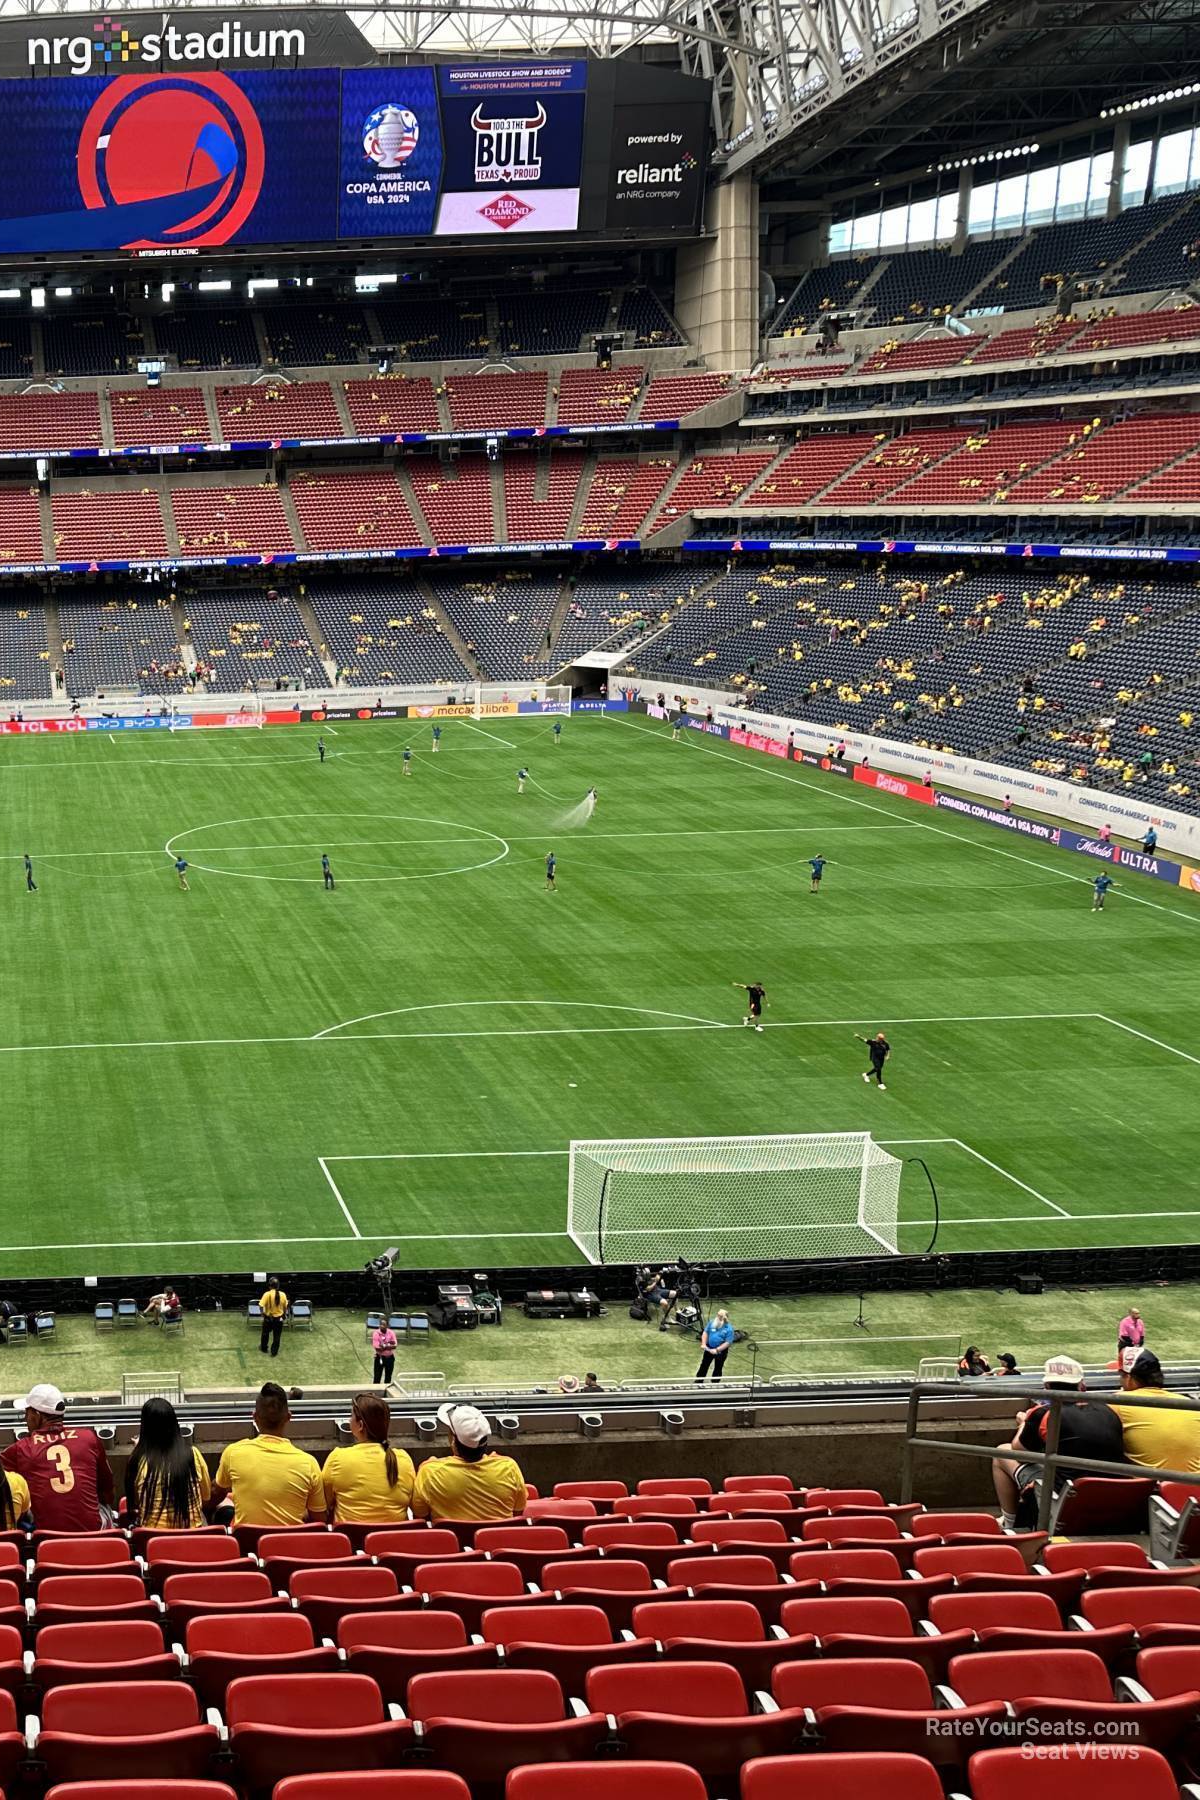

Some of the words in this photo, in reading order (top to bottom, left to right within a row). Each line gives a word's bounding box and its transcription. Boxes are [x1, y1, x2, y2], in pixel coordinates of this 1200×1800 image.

[27, 36, 92, 75] nrg
[140, 21, 305, 62] stadium
[449, 71, 479, 79] HOUSTON
[479, 70, 511, 78] LIVESTOCK
[511, 69, 530, 77] SHOW
[493, 121, 511, 131] 100.3
[512, 120, 525, 130] THE
[627, 133, 670, 147] powered
[670, 133, 683, 145] by
[477, 131, 540, 168] BULL
[477, 169, 499, 180] TEXAS
[514, 168, 539, 178] PROUD
[617, 163, 683, 184] reliant
[346, 182, 377, 194] COPA
[378, 180, 431, 193] AMERICA
[366, 195, 385, 204] USA
[387, 194, 410, 203] 2024
[626, 190, 645, 199] NRG
[645, 190, 681, 199] company
[497, 200, 517, 208] RED
[484, 207, 529, 216] DIAMOND
[138, 249, 171, 257] MITSUBISHI
[171, 248, 199, 256] ELECTRIC
[485, 703, 509, 714] libre
[18, 721, 49, 732] TCL
[55, 720, 86, 731] TCL
[875, 773, 908, 796] Betano
[940, 796, 972, 814] CONMEBOL
[972, 808, 988, 820] COPA
[987, 810, 1017, 828] AMERICA
[1017, 820, 1031, 834] USA
[1031, 823, 1049, 838] 2024
[1076, 838, 1113, 859] Michelob
[1121, 850, 1159, 874] ULTRA
[33, 1429, 79, 1445] RUIZ
[46, 1444, 75, 1494] 3
